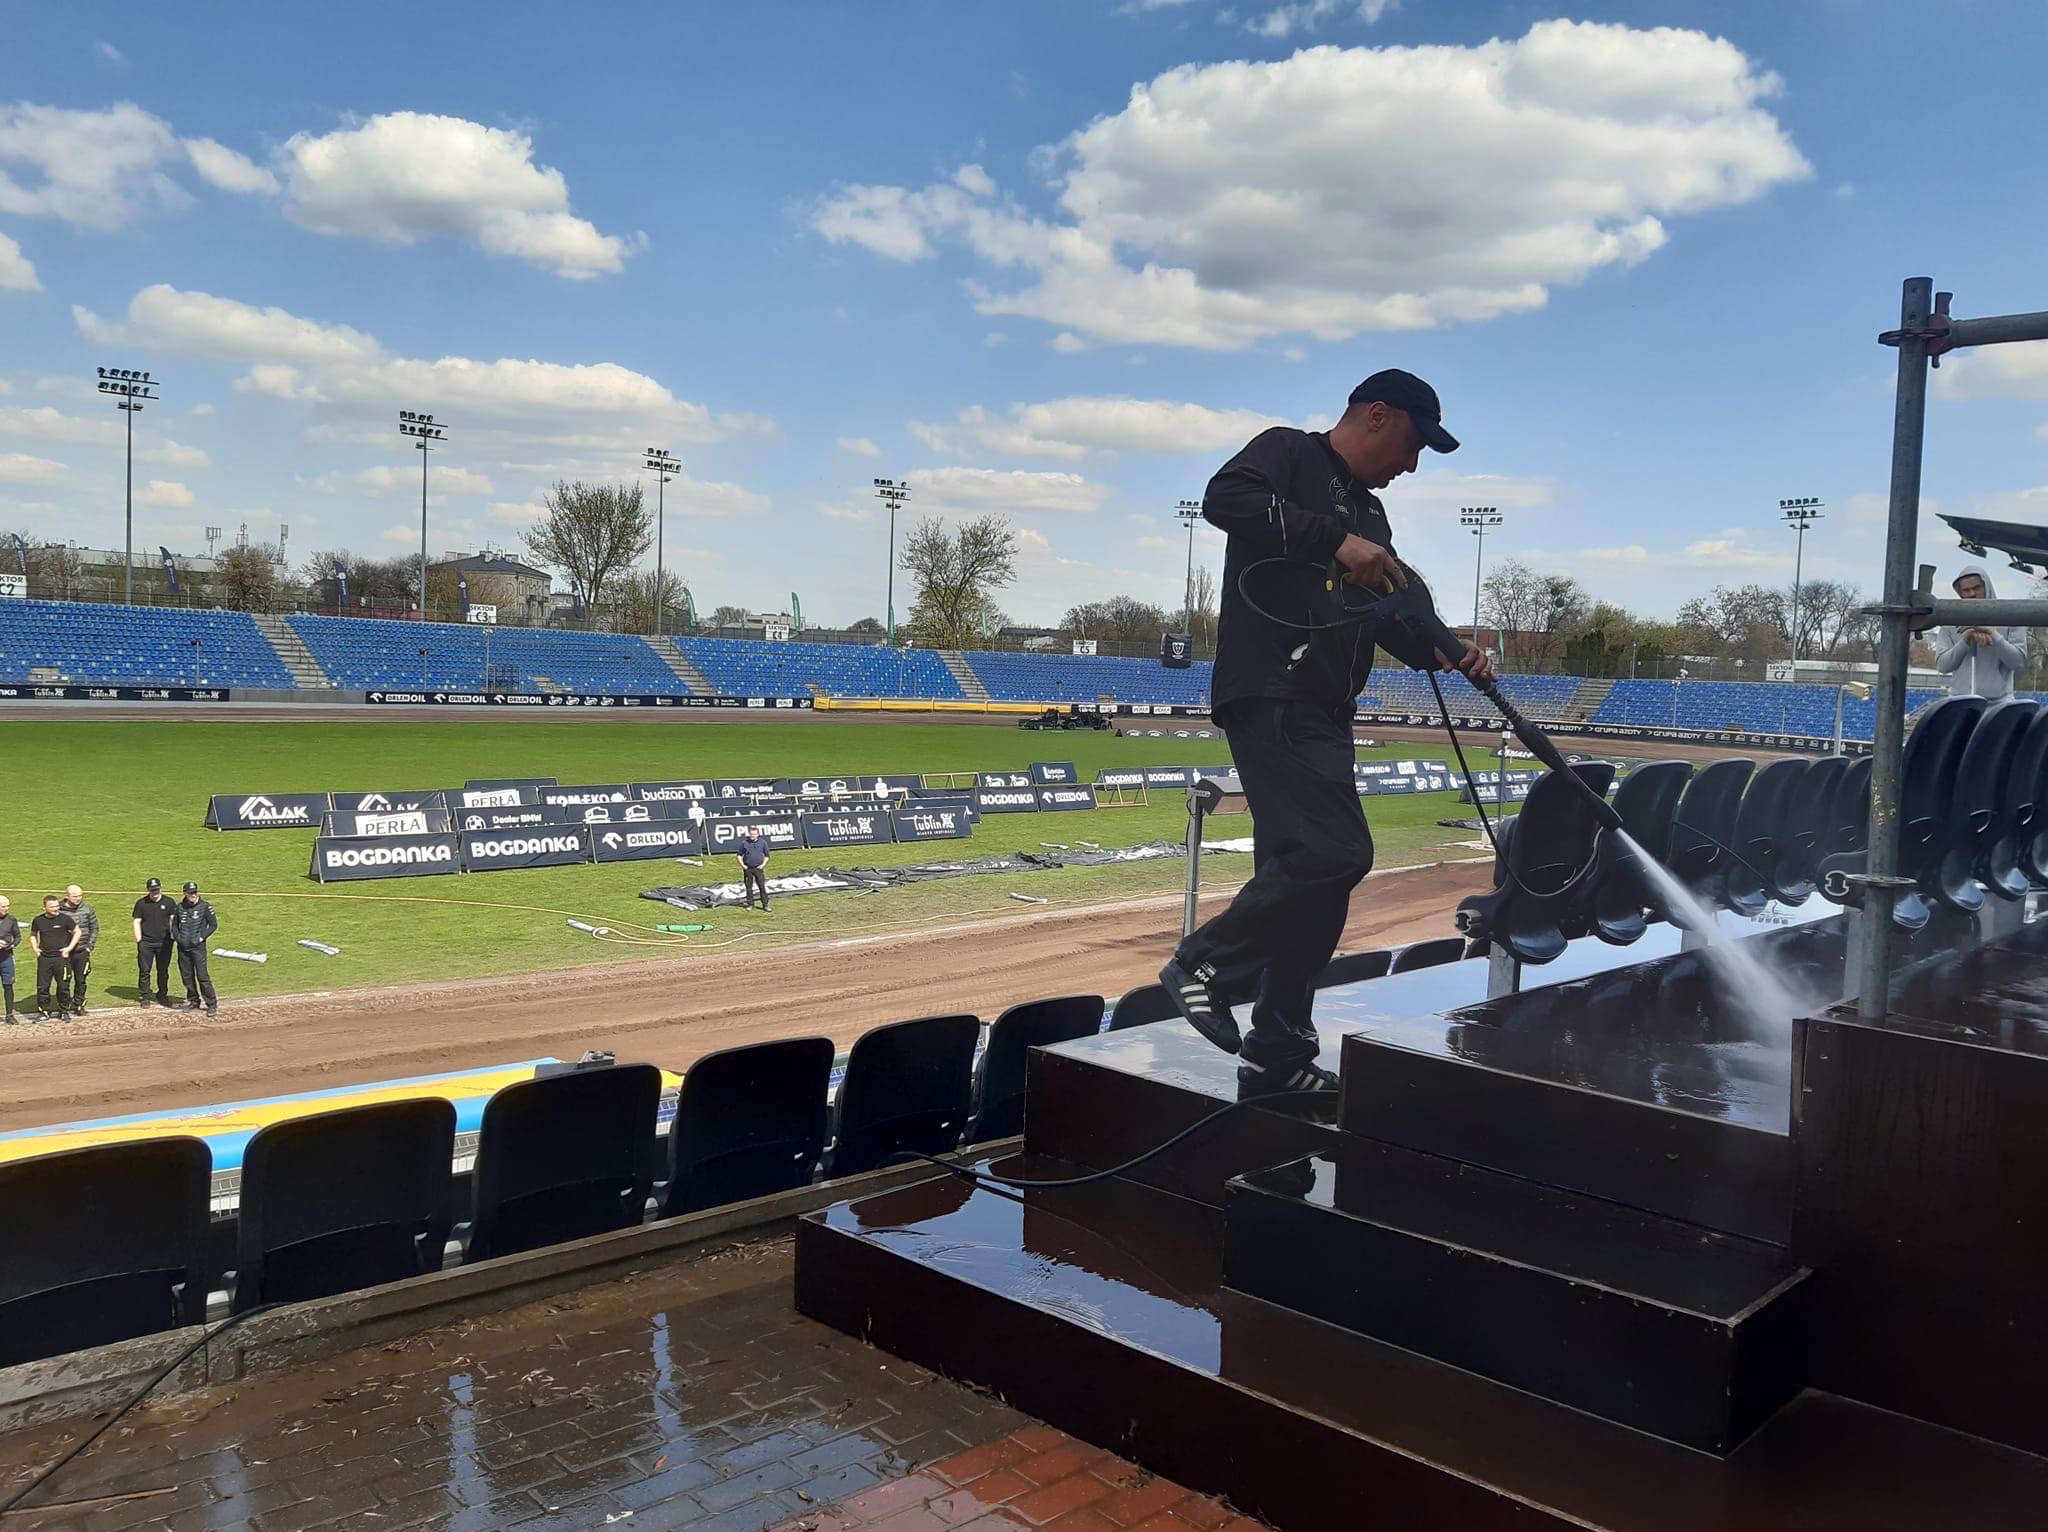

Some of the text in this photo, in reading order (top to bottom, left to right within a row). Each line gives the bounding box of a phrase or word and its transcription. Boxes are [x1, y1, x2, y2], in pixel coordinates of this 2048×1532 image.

[476, 611, 488, 621] C3
[411, 694, 426, 703] OIL
[472, 695, 487, 703] OIL
[529, 696, 542, 704] OIL
[980, 793, 1034, 805] BOGDANKA
[1076, 792, 1090, 801] OIL
[365, 818, 421, 835] PERŁA
[736, 823, 794, 837] PLTINUM
[630, 831, 692, 845] ORLEN OIL
[471, 836, 580, 858] BOGDANKA
[326, 845, 451, 868] BOGDANKA
